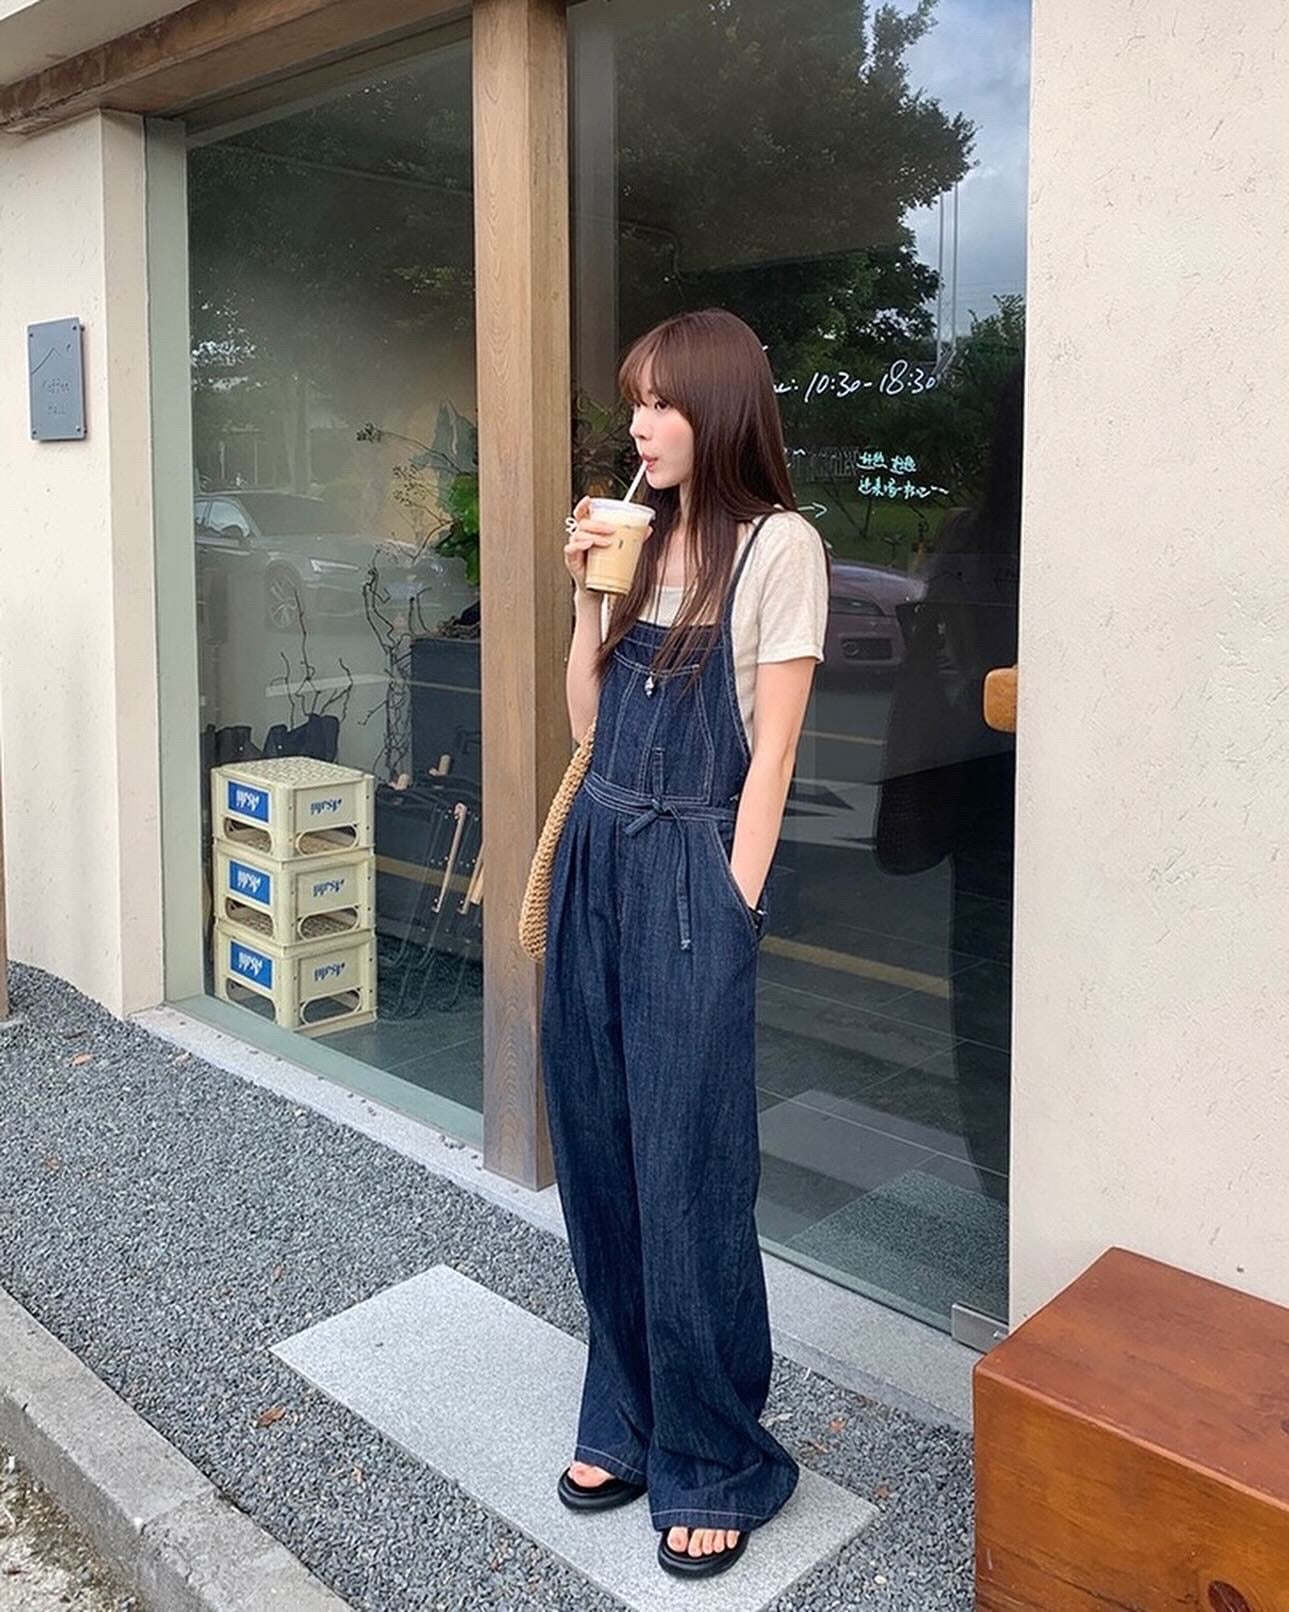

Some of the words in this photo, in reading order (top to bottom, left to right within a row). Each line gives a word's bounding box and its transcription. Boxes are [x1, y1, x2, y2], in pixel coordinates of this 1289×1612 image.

[804, 359, 936, 403] 10:30-18:30
[236, 789, 261, 812] Asahi
[310, 797, 343, 816] Asahi
[236, 869, 262, 893] Asahi
[312, 878, 345, 898] Asahi
[237, 951, 263, 977] Asahi
[313, 961, 346, 982] Asahi
